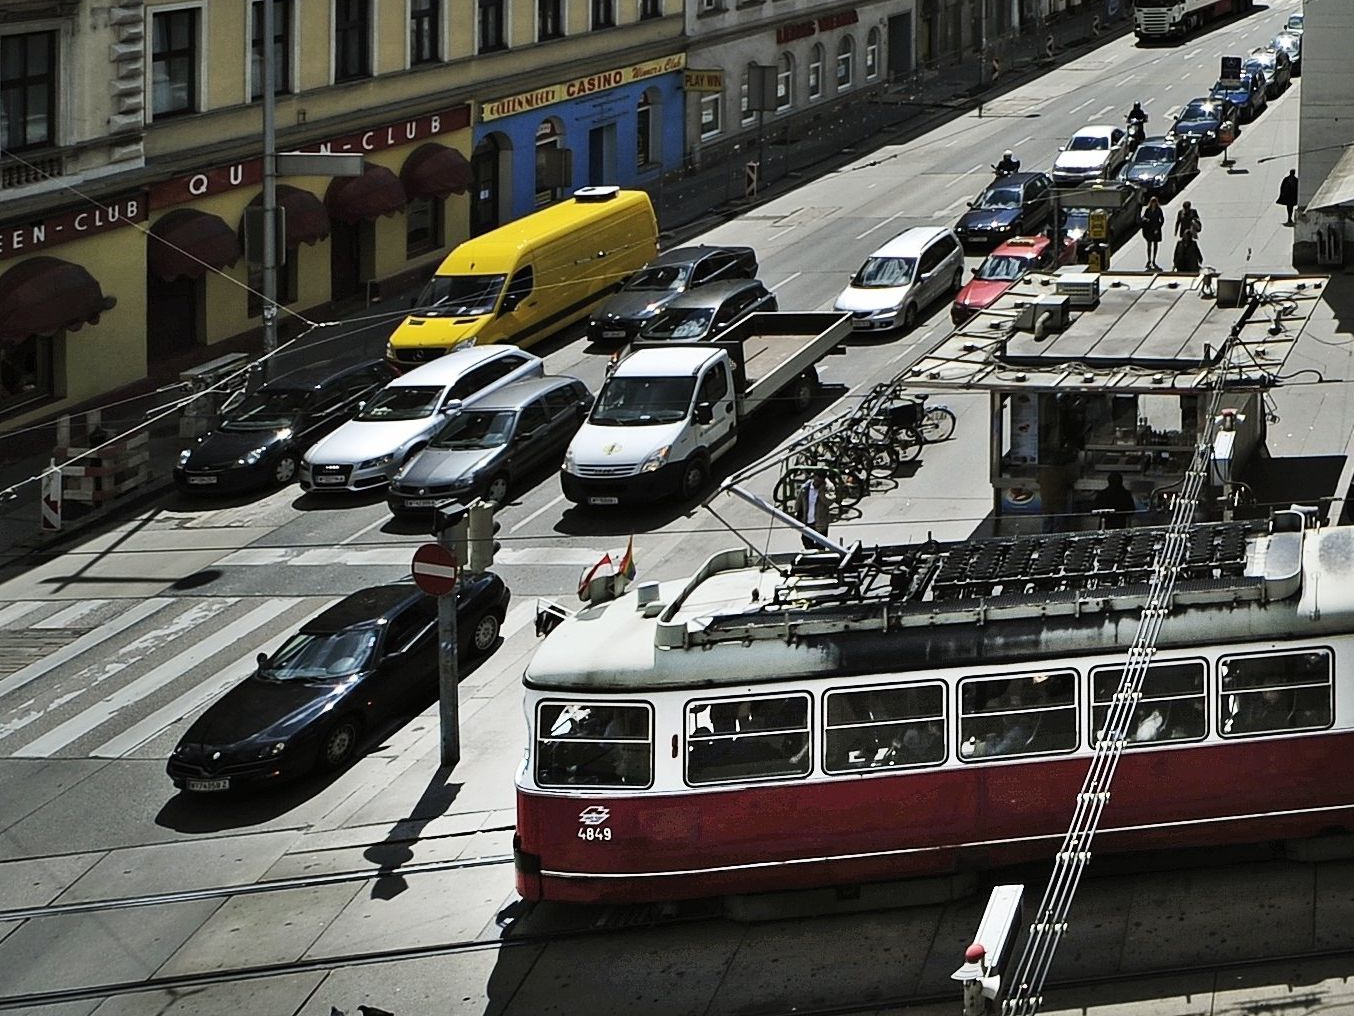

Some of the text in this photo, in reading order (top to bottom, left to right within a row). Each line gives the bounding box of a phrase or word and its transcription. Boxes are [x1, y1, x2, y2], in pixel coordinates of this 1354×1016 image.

[566, 71, 623, 97] CASINO
[0, 201, 138, 253] EN-CLUB
[577, 827, 612, 841] 4849
